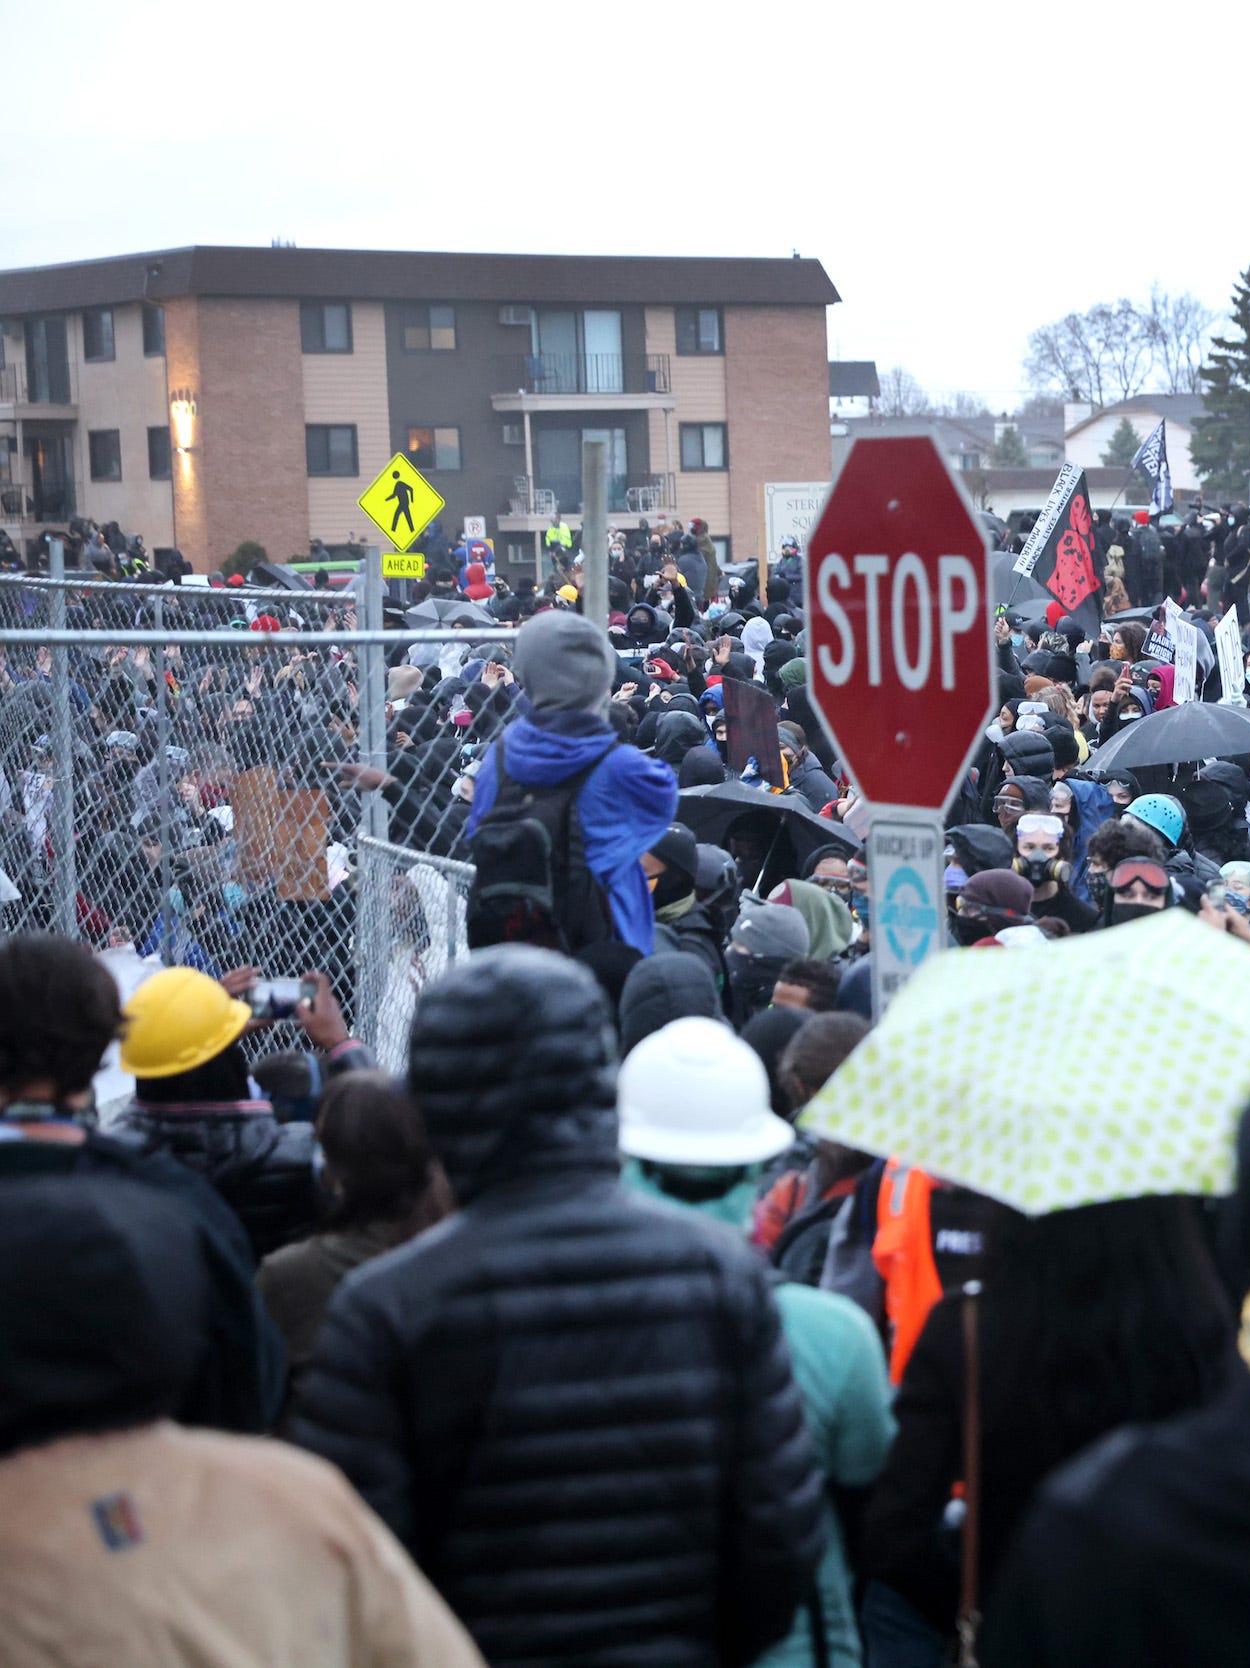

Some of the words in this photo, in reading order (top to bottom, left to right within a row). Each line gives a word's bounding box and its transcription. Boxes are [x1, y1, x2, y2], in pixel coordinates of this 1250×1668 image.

[1053, 463, 1073, 495] BLACK
[1039, 500, 1056, 522] LIVES
[792, 516, 816, 529] SQU
[387, 560, 419, 571] AHEAD
[817, 553, 978, 691] STOP
[1151, 631, 1177, 652] DAUNTE
